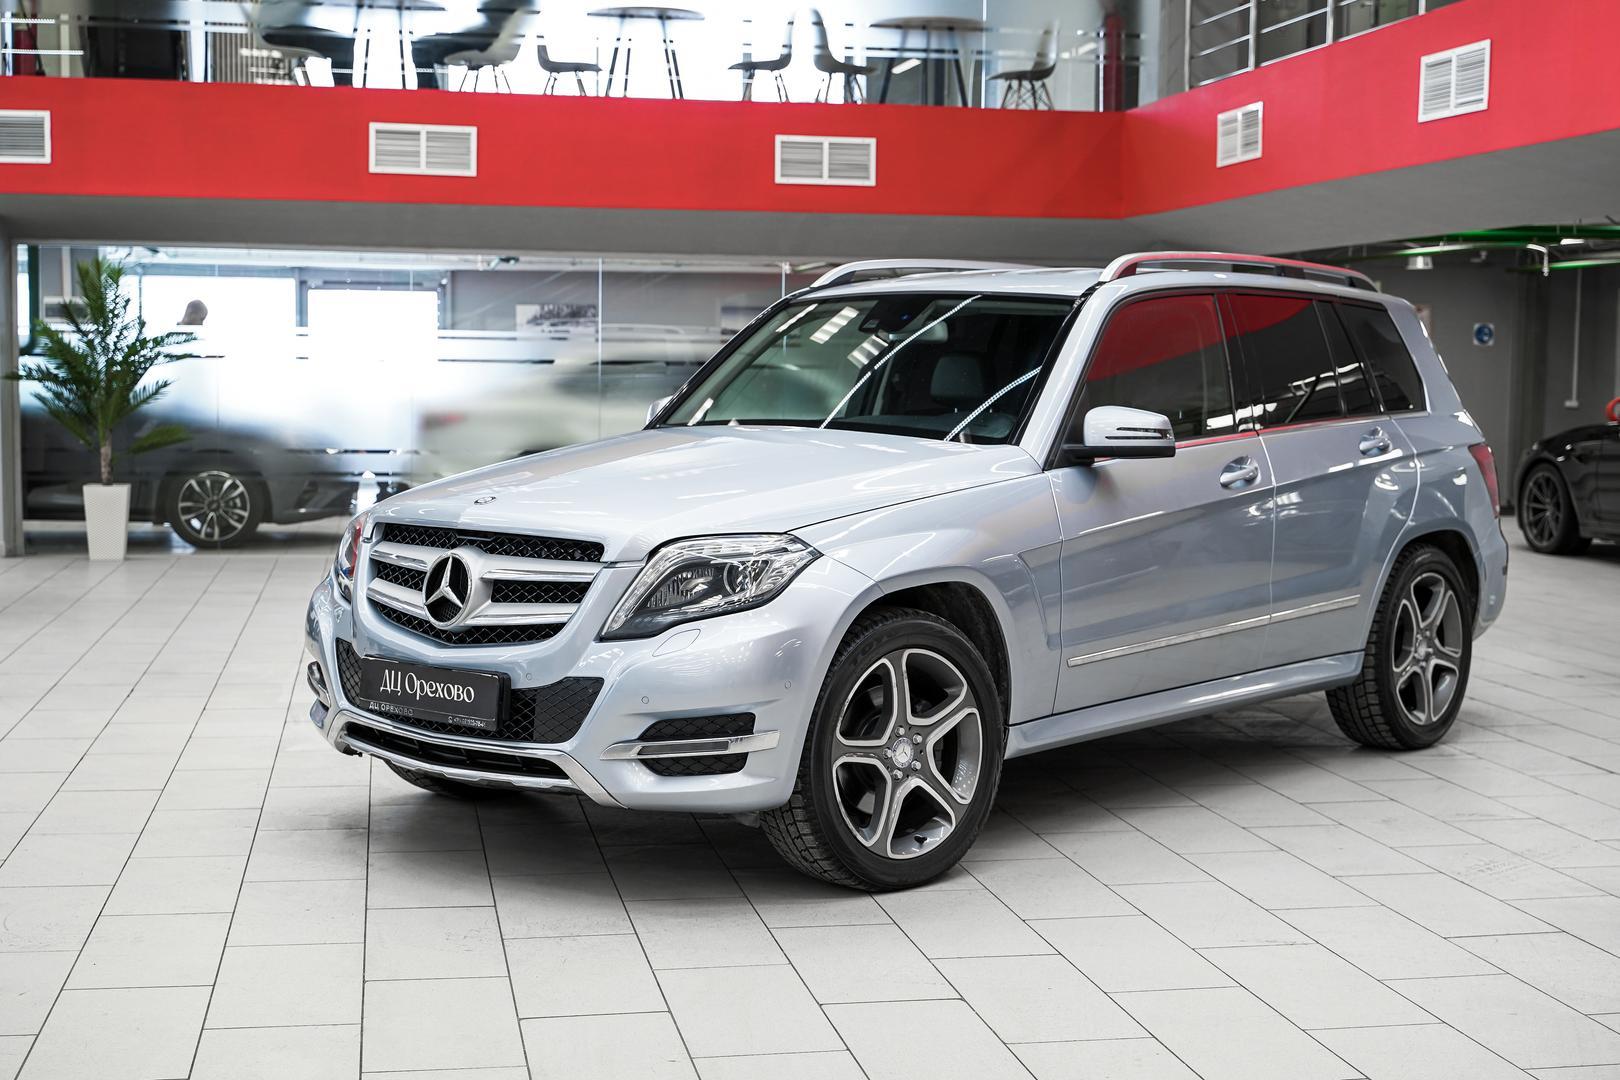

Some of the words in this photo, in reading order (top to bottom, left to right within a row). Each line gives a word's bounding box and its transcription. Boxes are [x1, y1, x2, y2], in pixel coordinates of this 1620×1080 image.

[380, 669, 402, 696] ДЦ
[405, 672, 475, 703] Орехово
[369, 702, 379, 710] ДЦ
[380, 703, 413, 716] ОРЕХОВО
